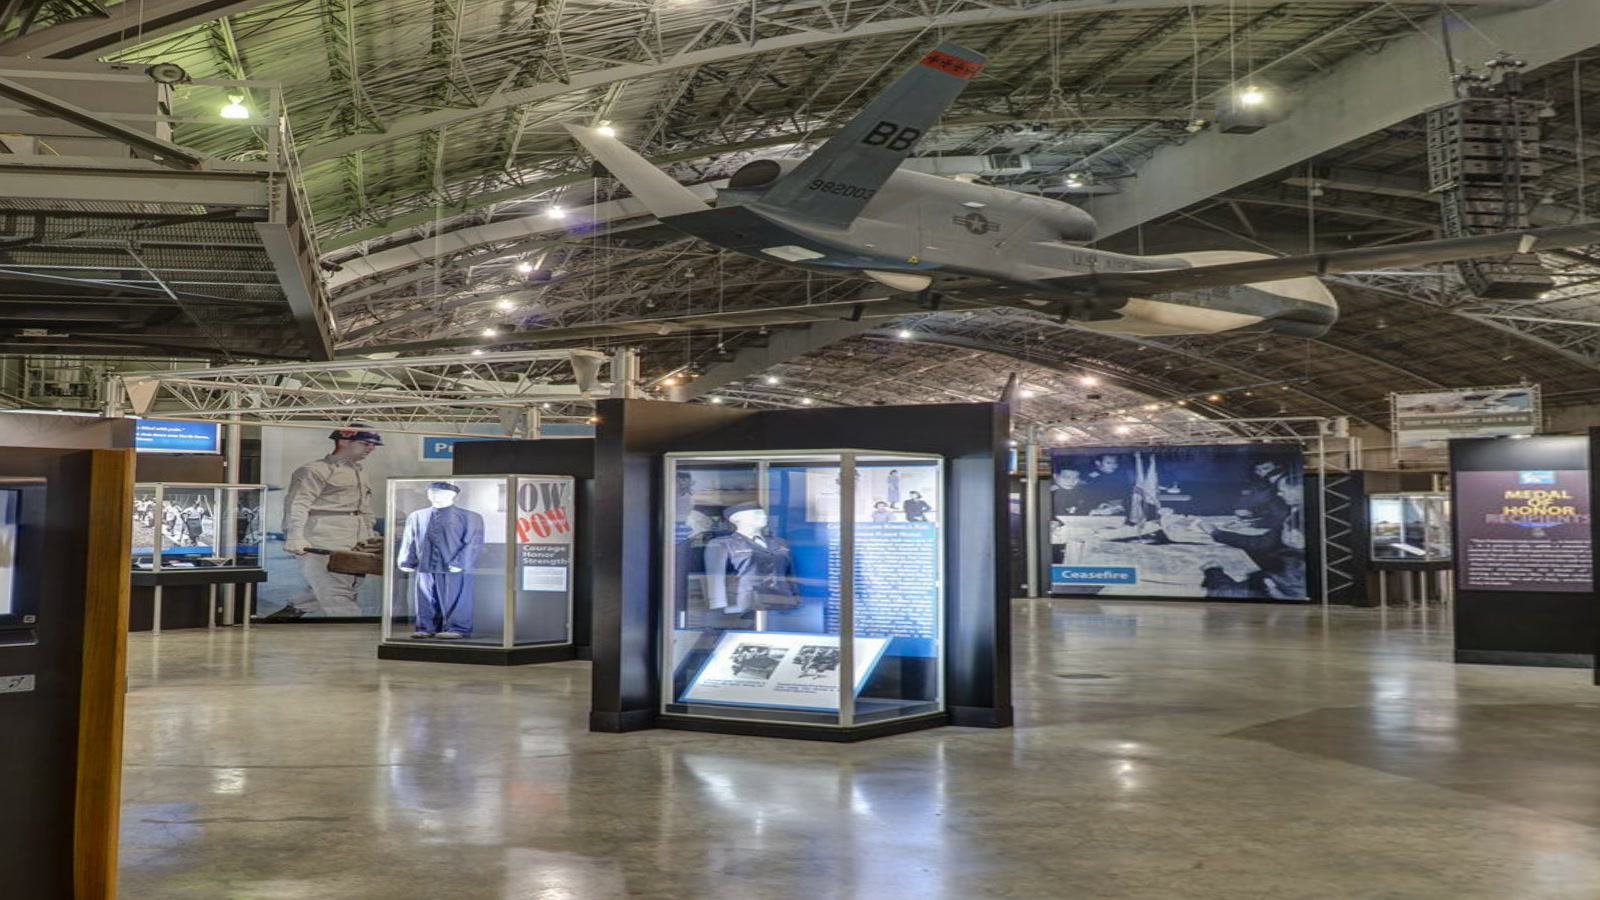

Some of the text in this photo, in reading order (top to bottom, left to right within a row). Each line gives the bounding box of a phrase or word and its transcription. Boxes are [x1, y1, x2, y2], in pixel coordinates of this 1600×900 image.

[861, 121, 920, 152] BB
[808, 179, 877, 200] 982003
[1504, 489, 1573, 500] MEDAL
[1527, 498, 1554, 507] OF
[1503, 506, 1575, 516] HONOR
[522, 544, 566, 553] Courage
[522, 558, 567, 566] Strength
[1061, 570, 1129, 580] Ceasefire
